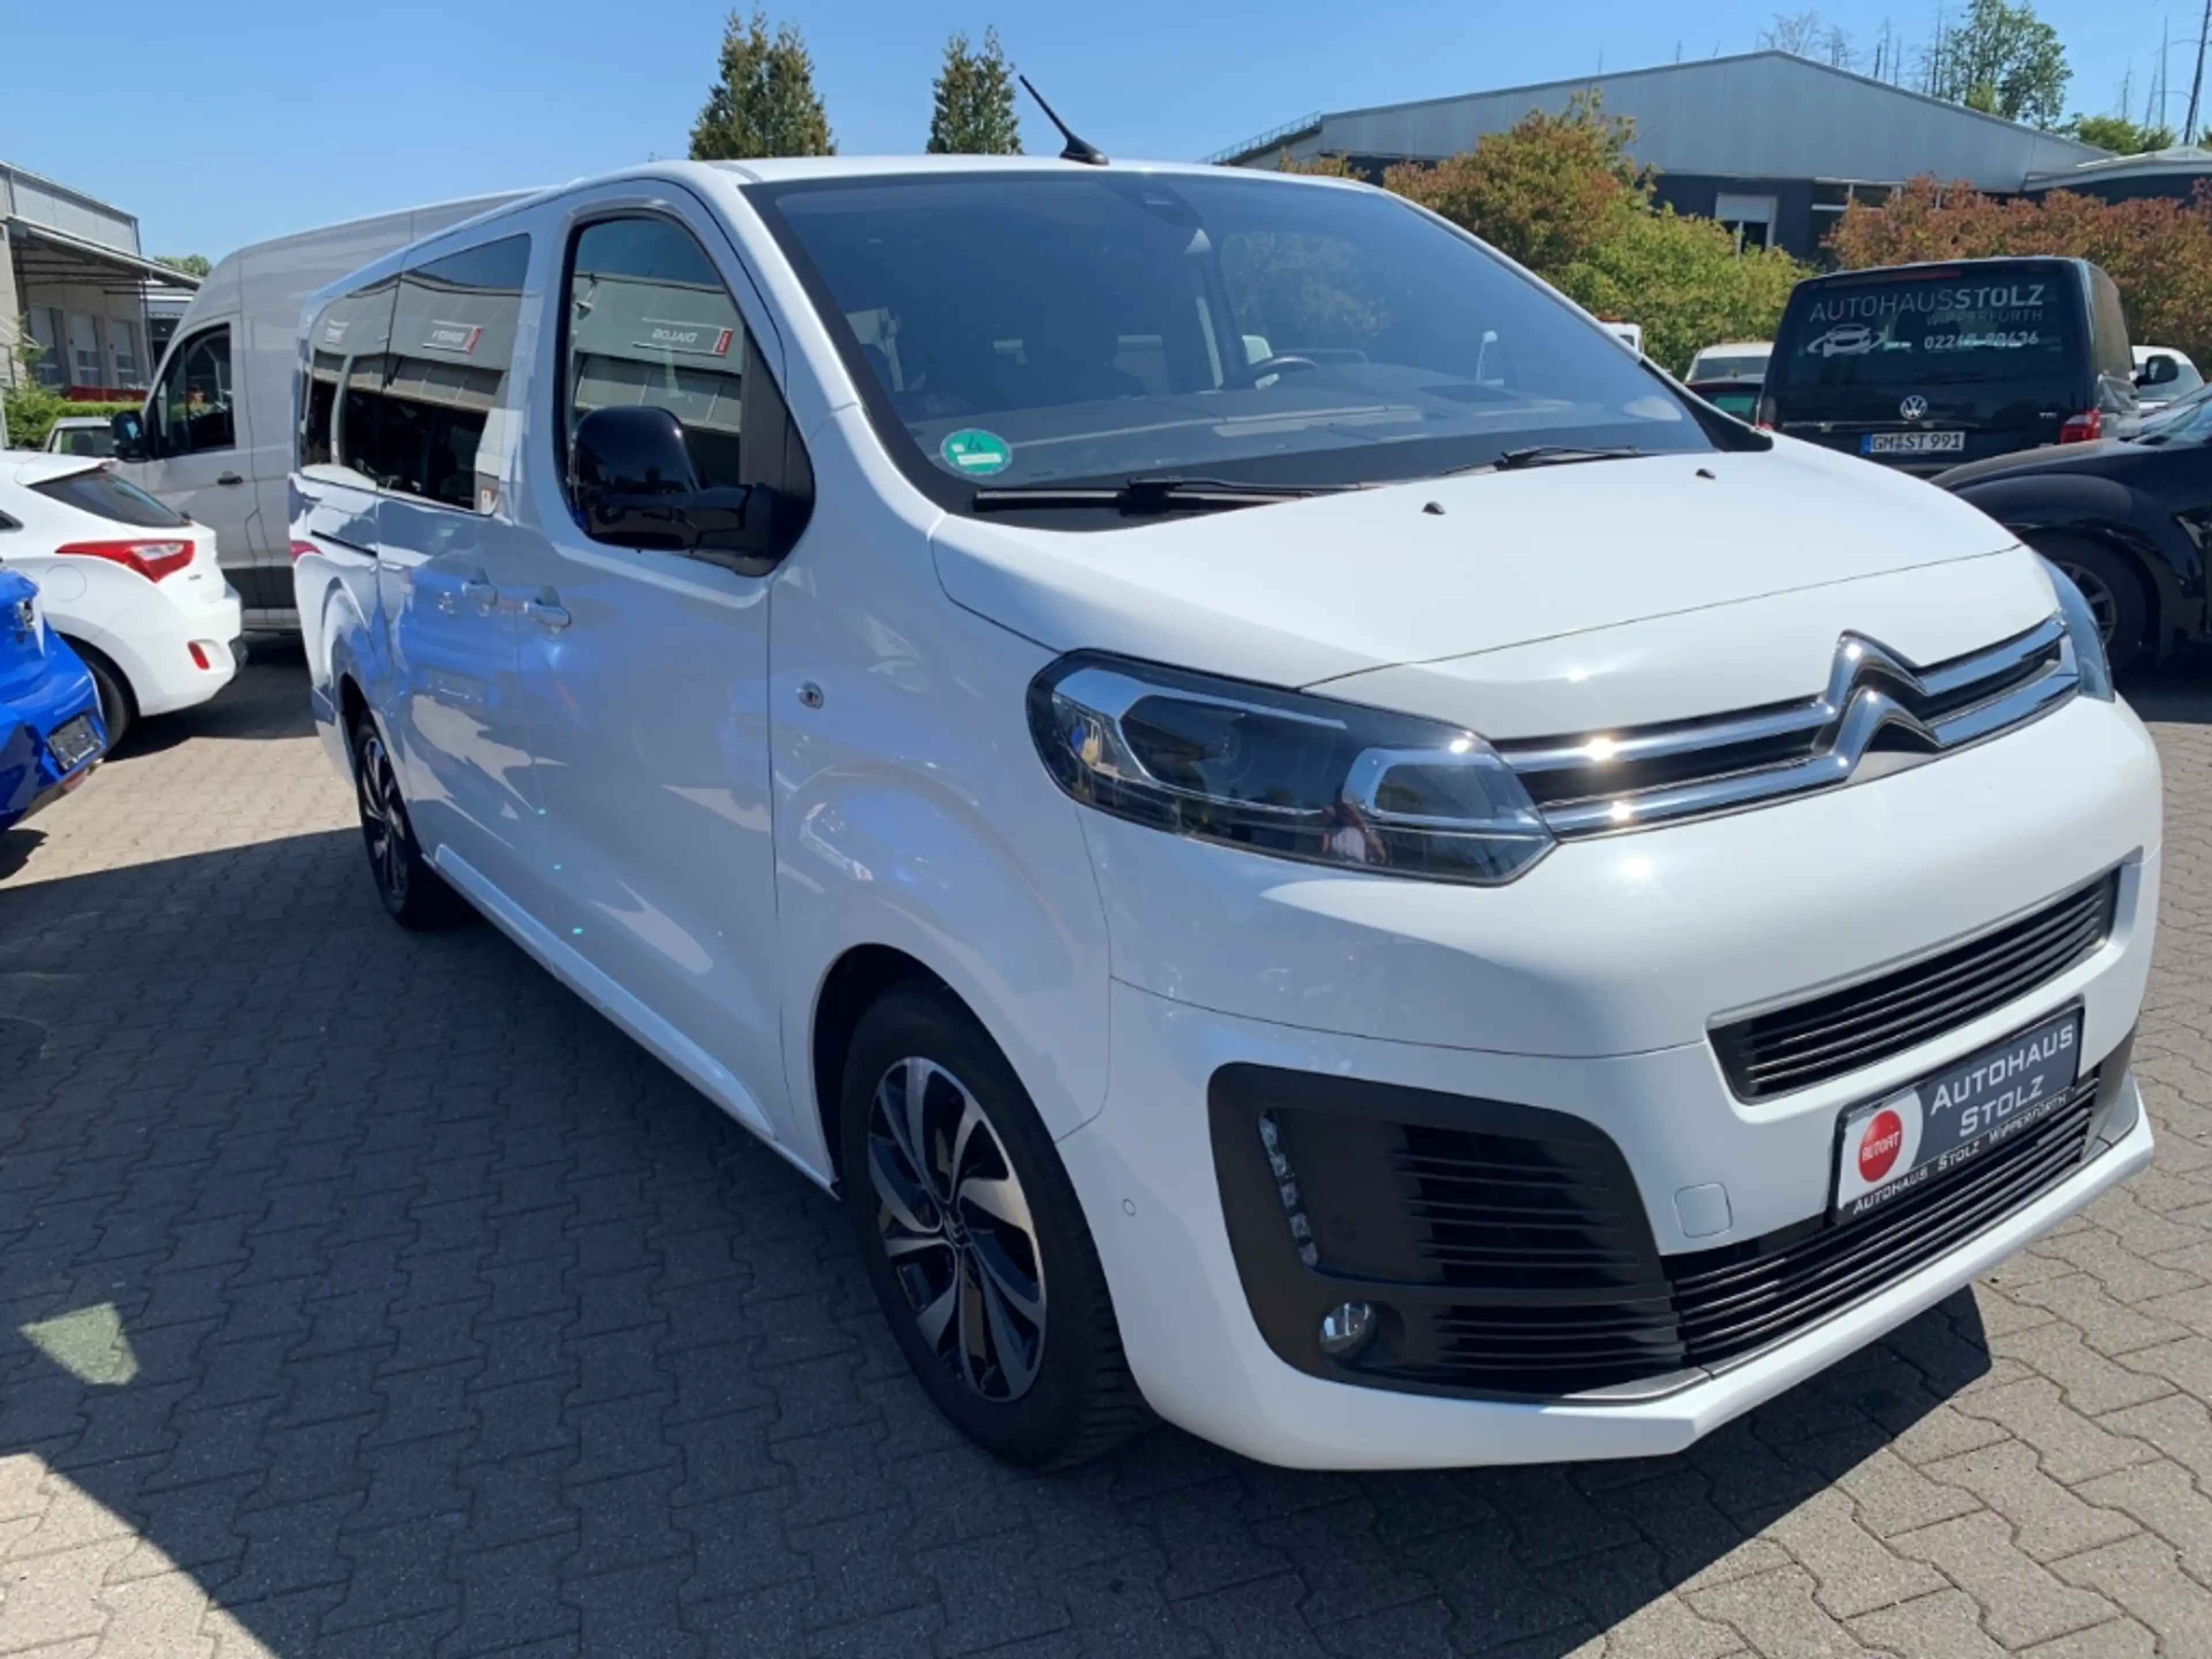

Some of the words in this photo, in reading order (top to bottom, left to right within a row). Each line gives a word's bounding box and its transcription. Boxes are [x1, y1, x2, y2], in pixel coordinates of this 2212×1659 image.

[1930, 433, 1961, 448] 991
[1930, 1024, 2073, 1116] AUTOHAUS
[1959, 1074, 2044, 1138] STOLZ
[1853, 1167, 1927, 1215] AUTOHAUS
[1938, 1140, 1980, 1171] STOLZ
